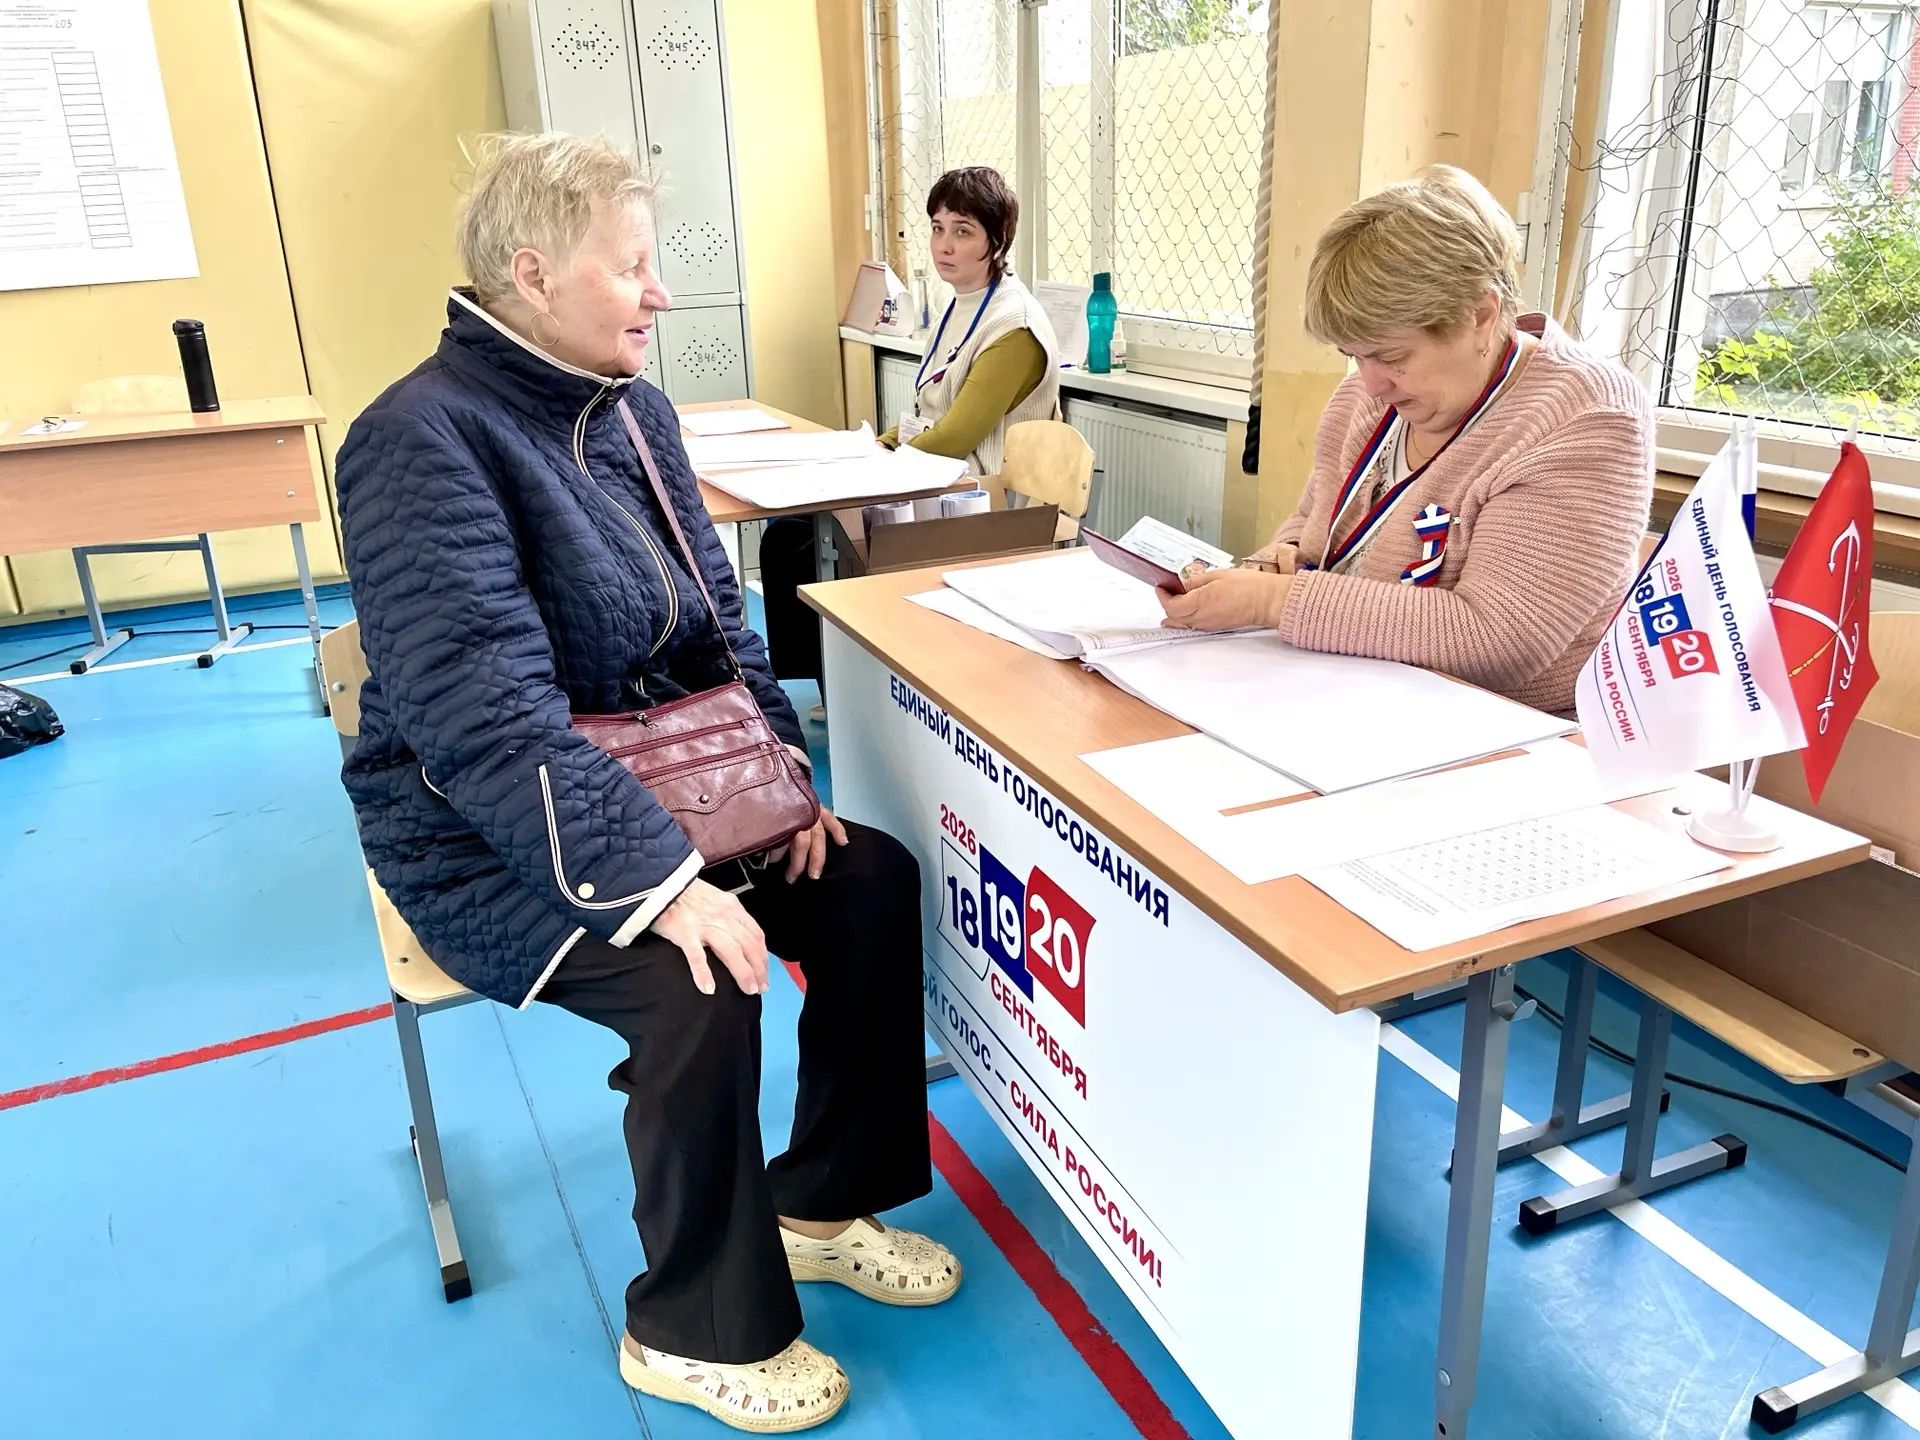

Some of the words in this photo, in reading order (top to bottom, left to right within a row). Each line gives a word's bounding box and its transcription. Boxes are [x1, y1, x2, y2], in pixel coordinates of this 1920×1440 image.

[575, 40, 596, 50] 847
[668, 41, 688, 52] 845
[1692, 497, 1719, 560] ЕДИНЫЙ
[1635, 573, 1655, 604] 18
[1665, 558, 1683, 592] 2026
[1705, 562, 1726, 601] ДЕНЬ
[1649, 602, 1679, 634] 19
[1601, 642, 1614, 680] СИЛА
[1627, 615, 1657, 688] СЕНТЯБРЯ
[1671, 634, 1705, 672] 20
[1719, 602, 1761, 712] ГОЛОСОВАНИЯ
[1606, 681, 1636, 742] РОССИИ!
[891, 675, 950, 745] ЕДИНЫЙ
[955, 727, 998, 783] ДЕНЬ
[1003, 765, 1169, 927] ГОЛОСОВАНИЯ
[940, 803, 976, 855] 2026
[948, 875, 979, 949] 18
[985, 881, 1022, 960] 19
[1030, 893, 1081, 989] 20
[990, 972, 1087, 1100] СЕНТЯБРЯ
[942, 993, 991, 1071] ГОЛОС
[1010, 1080, 1060, 1160] СИЛА
[1065, 1145, 1162, 1288] РОССИИ!
